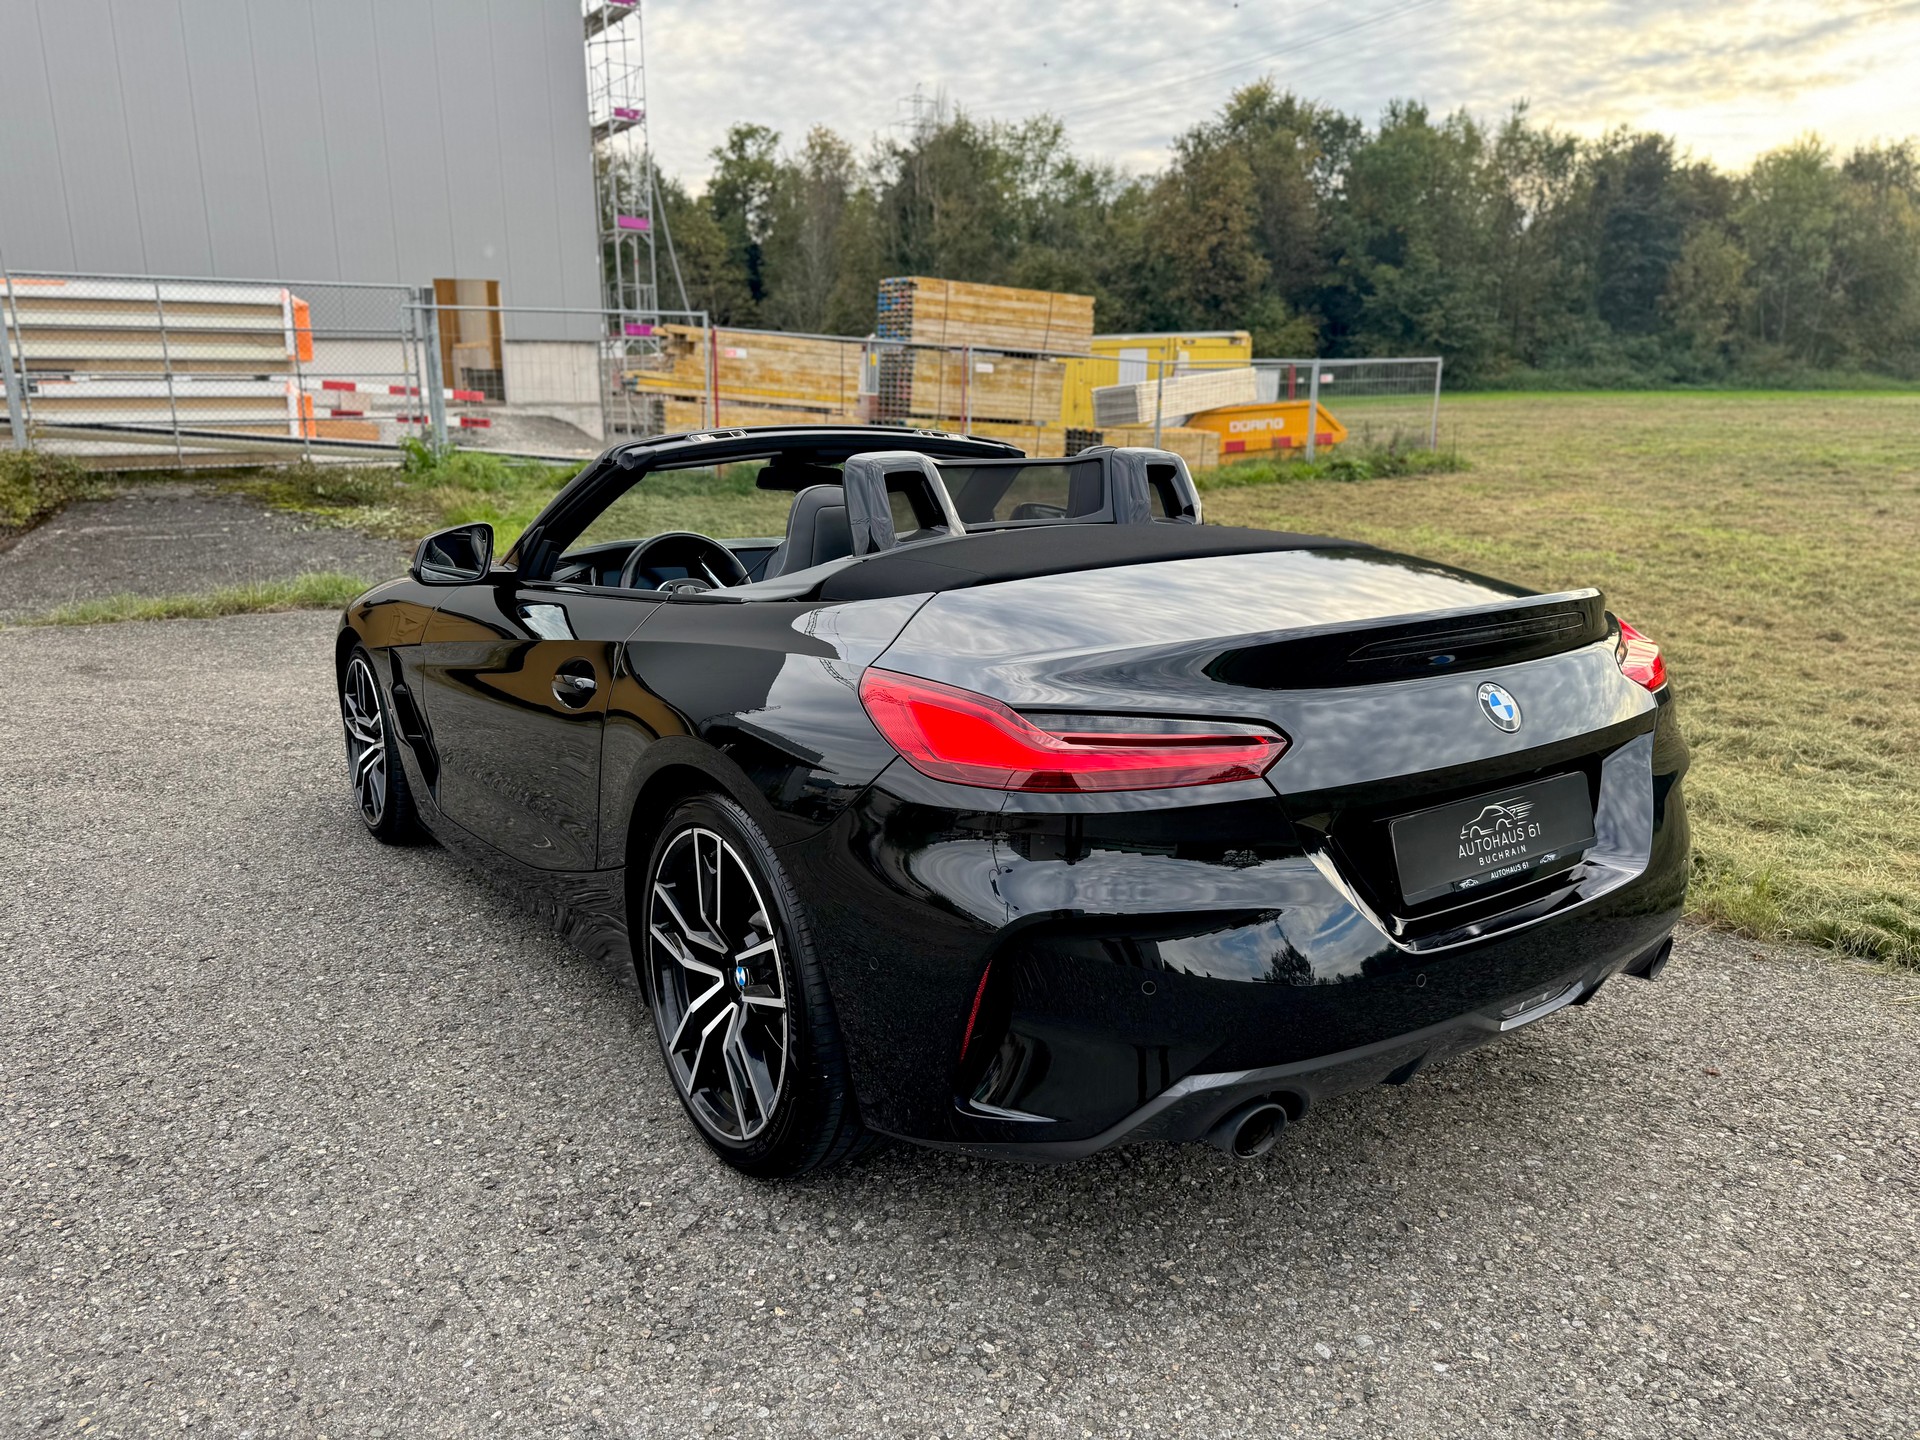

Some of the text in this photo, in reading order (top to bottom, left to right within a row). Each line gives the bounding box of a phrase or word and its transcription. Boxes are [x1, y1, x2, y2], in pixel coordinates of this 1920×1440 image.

[1459, 822, 1541, 858] AUTOHAUS 61
[1479, 845, 1527, 866] BUCHRAIN
[1490, 861, 1529, 879] AUTOHAUS 61
